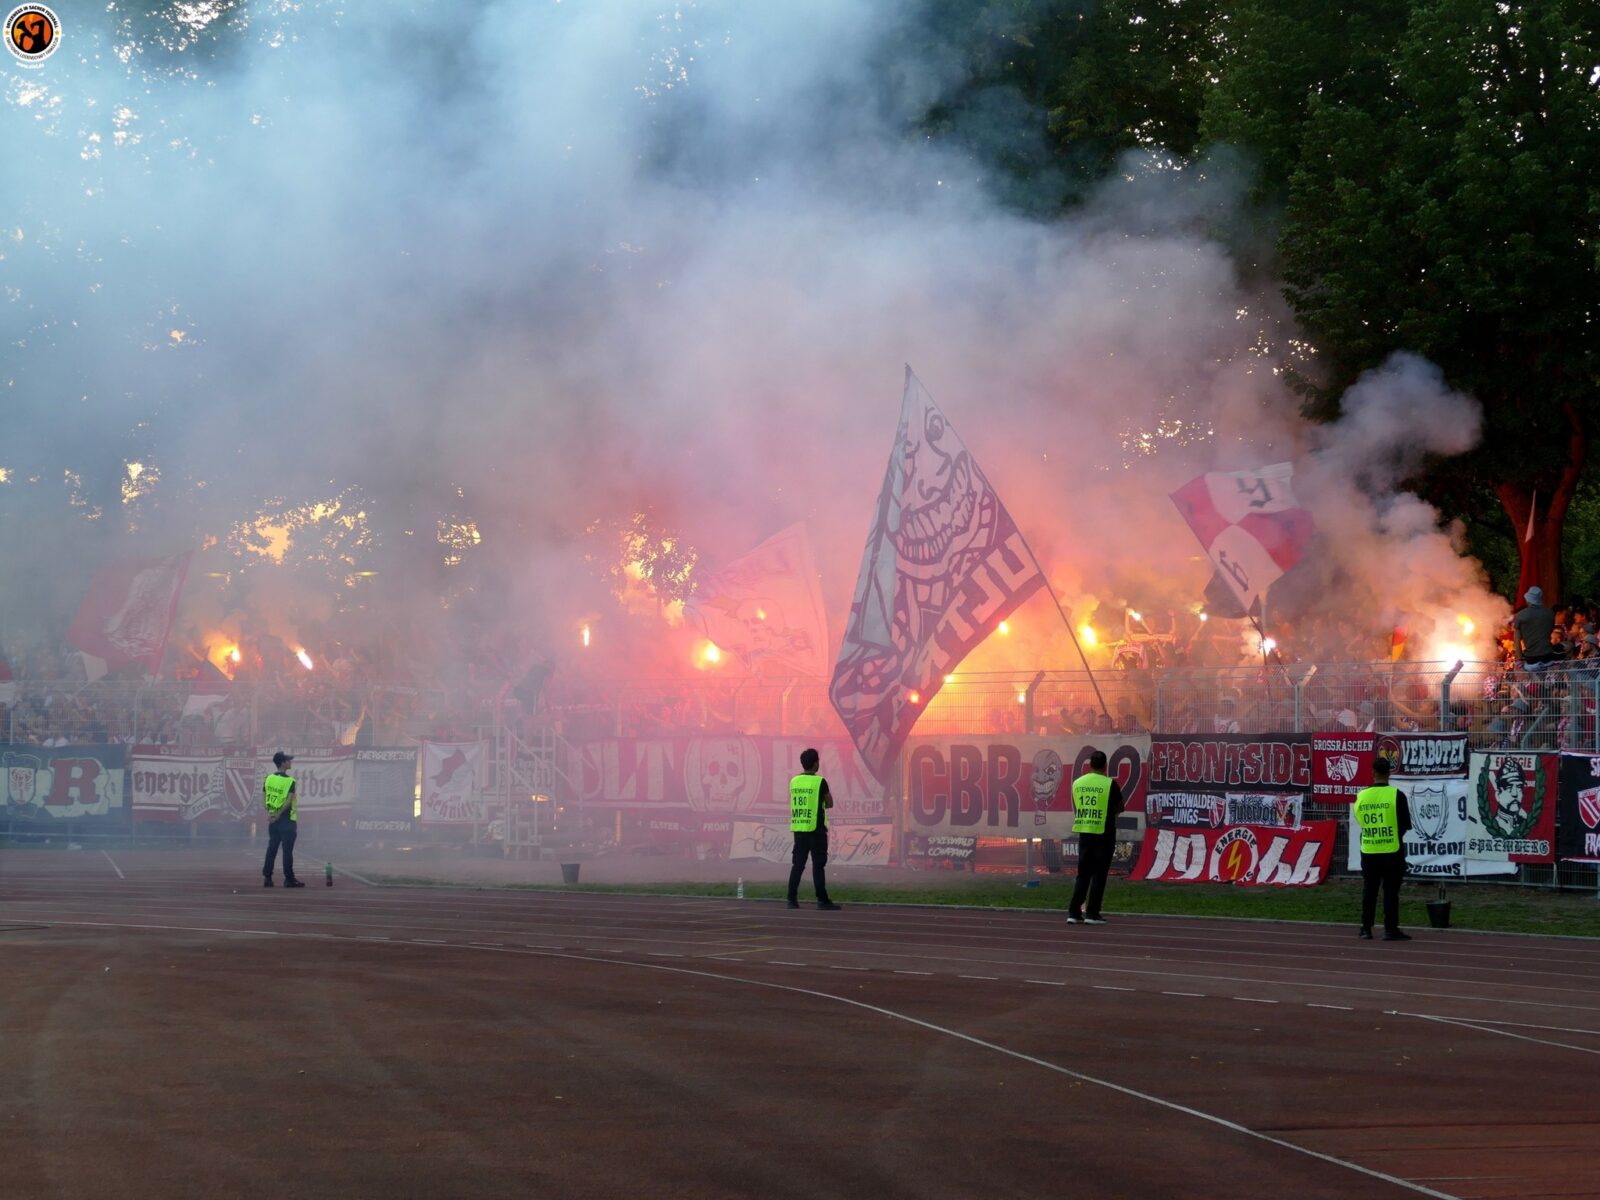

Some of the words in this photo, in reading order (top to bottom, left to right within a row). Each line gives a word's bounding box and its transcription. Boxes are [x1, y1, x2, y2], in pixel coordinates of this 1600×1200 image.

[1314, 738, 1374, 752] GROSSRÄSCHEN
[1401, 739, 1467, 767] VERBOTEN
[1151, 741, 1311, 786] FRONTSIDE
[133, 764, 211, 803] energie
[911, 744, 1022, 829] CBR
[793, 796, 808, 806] 180
[834, 800, 885, 815] NERGIE
[1078, 795, 1097, 807] 126
[1159, 793, 1218, 810] FINSTERWALDER
[1077, 808, 1104, 819] MPIRE
[1171, 808, 1199, 824] JUNGS
[1363, 813, 1384, 825] 061
[702, 821, 732, 832] FRONT
[1215, 828, 1258, 855] ENERGIE
[1469, 838, 1550, 856] SPREMBERG
[927, 847, 974, 858] COMPANY
